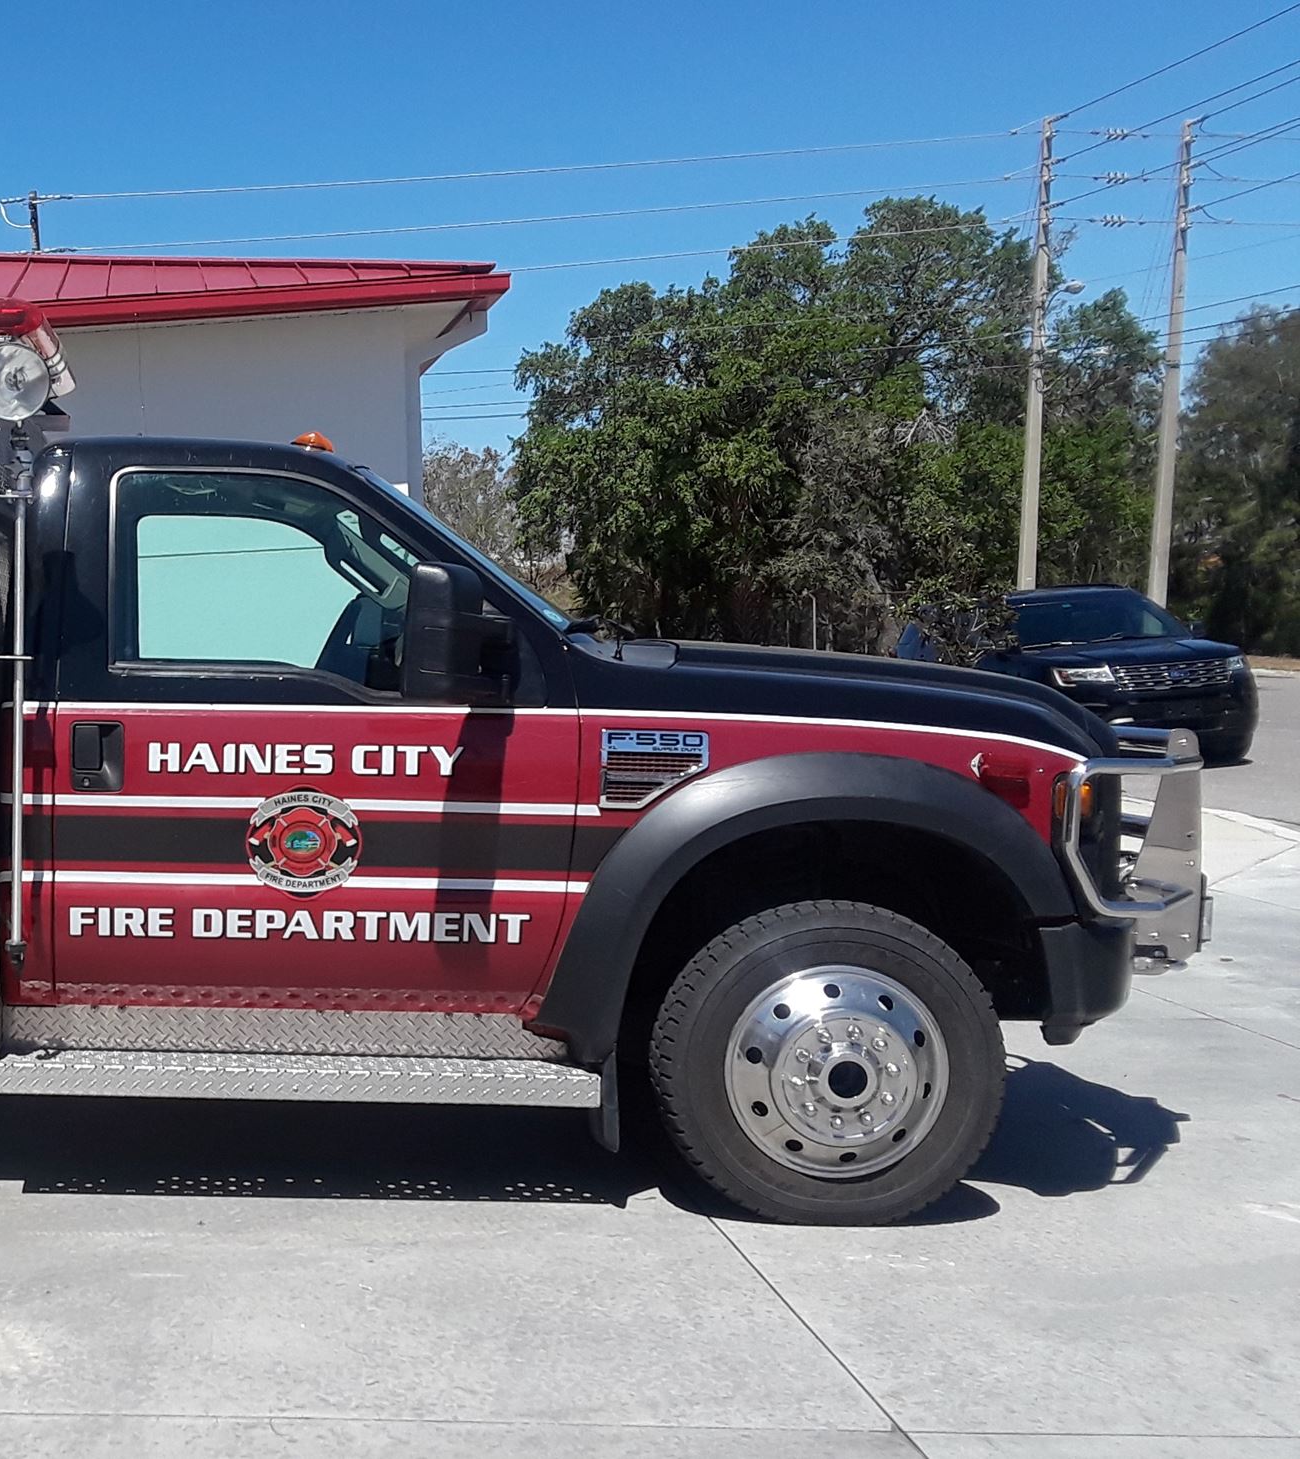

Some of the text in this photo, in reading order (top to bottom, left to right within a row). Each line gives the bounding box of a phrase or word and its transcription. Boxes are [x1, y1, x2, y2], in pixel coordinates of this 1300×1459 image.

[607, 732, 703, 747] F-550
[148, 742, 464, 777] HAINES CITY
[273, 793, 334, 807] HAINES CITY
[264, 872, 341, 889] FIRE DEPARTMENT
[68, 906, 532, 945] FIRE DEPARTMENT
